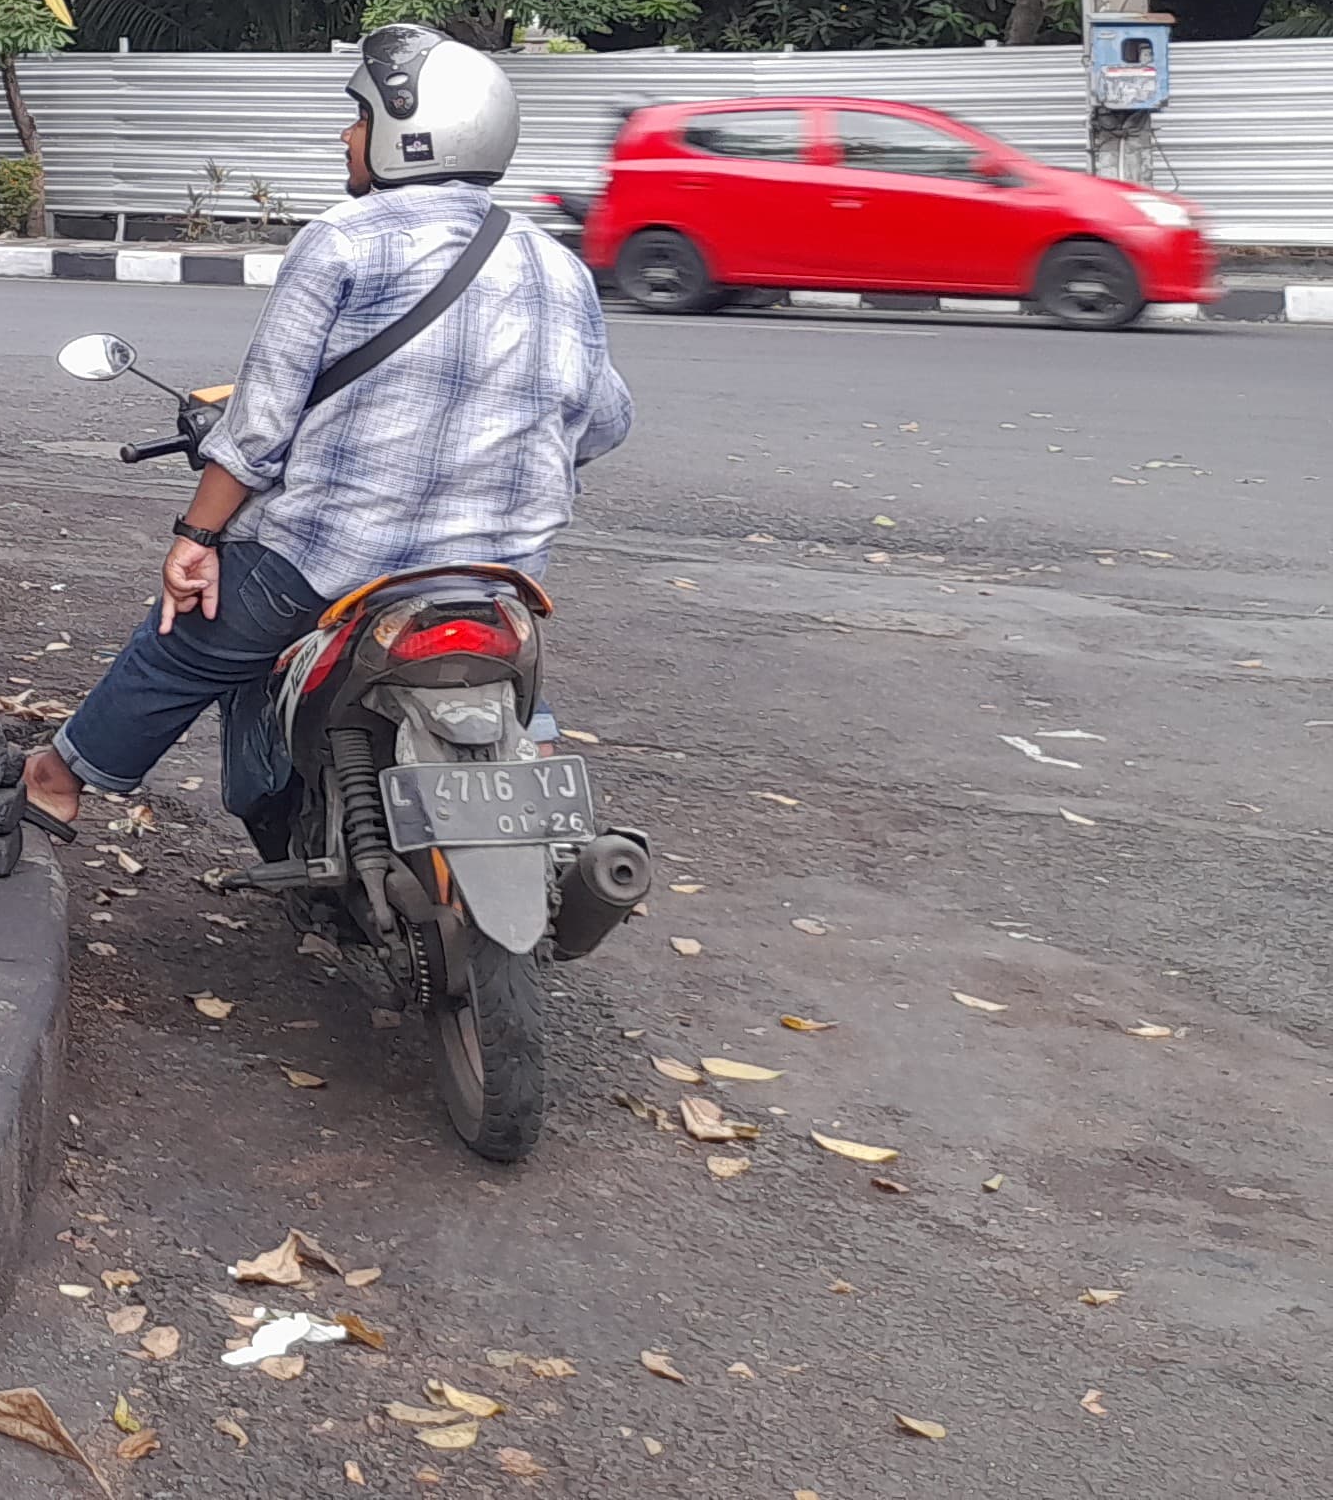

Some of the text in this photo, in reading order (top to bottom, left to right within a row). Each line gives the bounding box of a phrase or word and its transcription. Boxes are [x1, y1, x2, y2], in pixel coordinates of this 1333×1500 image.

[390, 763, 577, 807] L 4716 YJ
